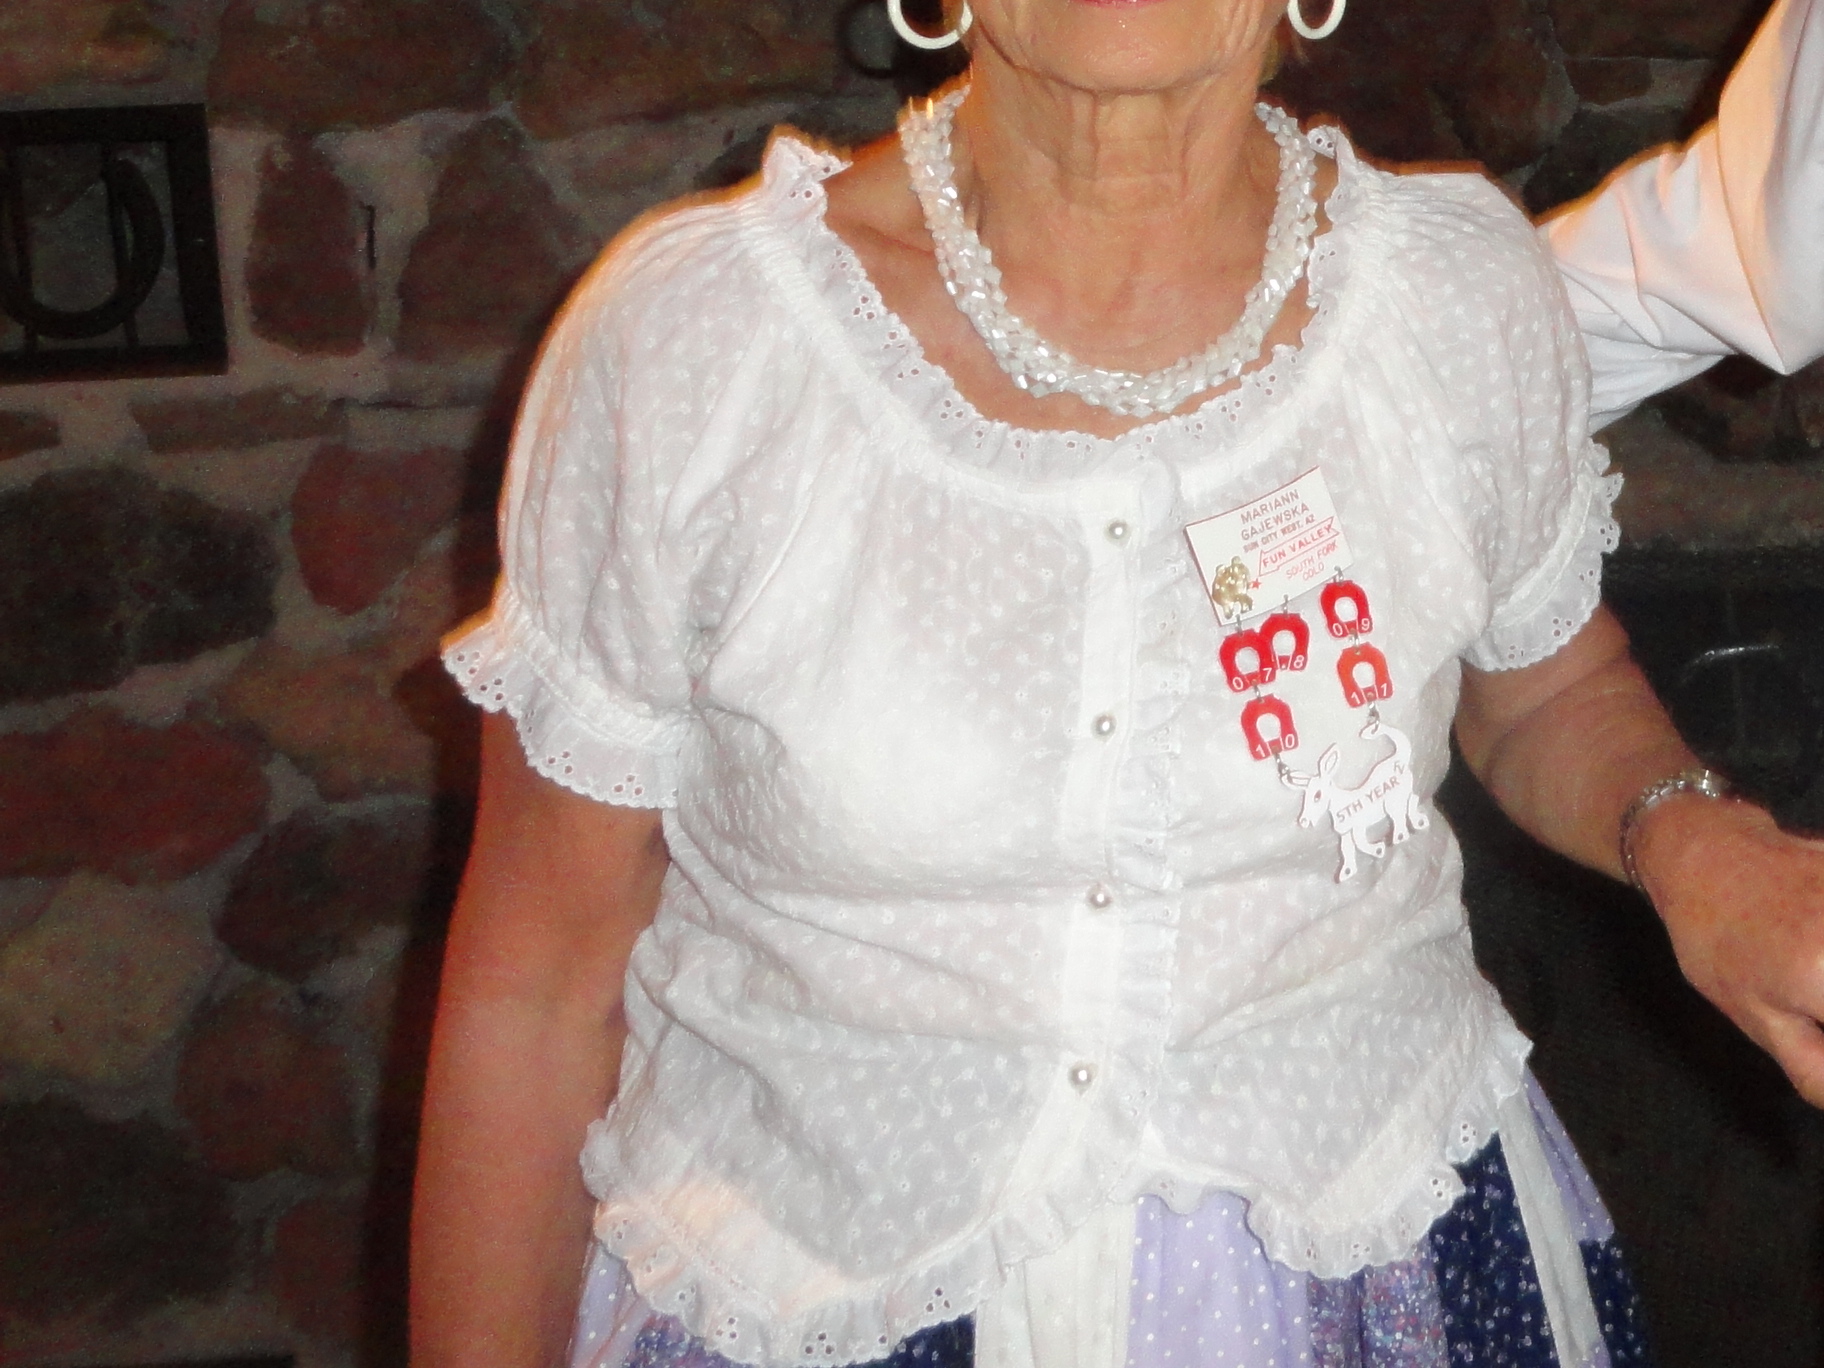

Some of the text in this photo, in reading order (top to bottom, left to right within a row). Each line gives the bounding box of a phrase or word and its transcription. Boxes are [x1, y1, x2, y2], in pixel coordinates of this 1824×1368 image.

[1240, 489, 1300, 524] MARIANN
[1241, 502, 1310, 541] GAJEWSKA
[1262, 525, 1332, 568] FUN VALLEY
[1286, 540, 1338, 579] SOUTH FORK
[1332, 618, 1371, 637] 09
[1232, 667, 1273, 691] 07
[1255, 733, 1295, 758] 10
[1336, 777, 1400, 823] 5TH YEAR
